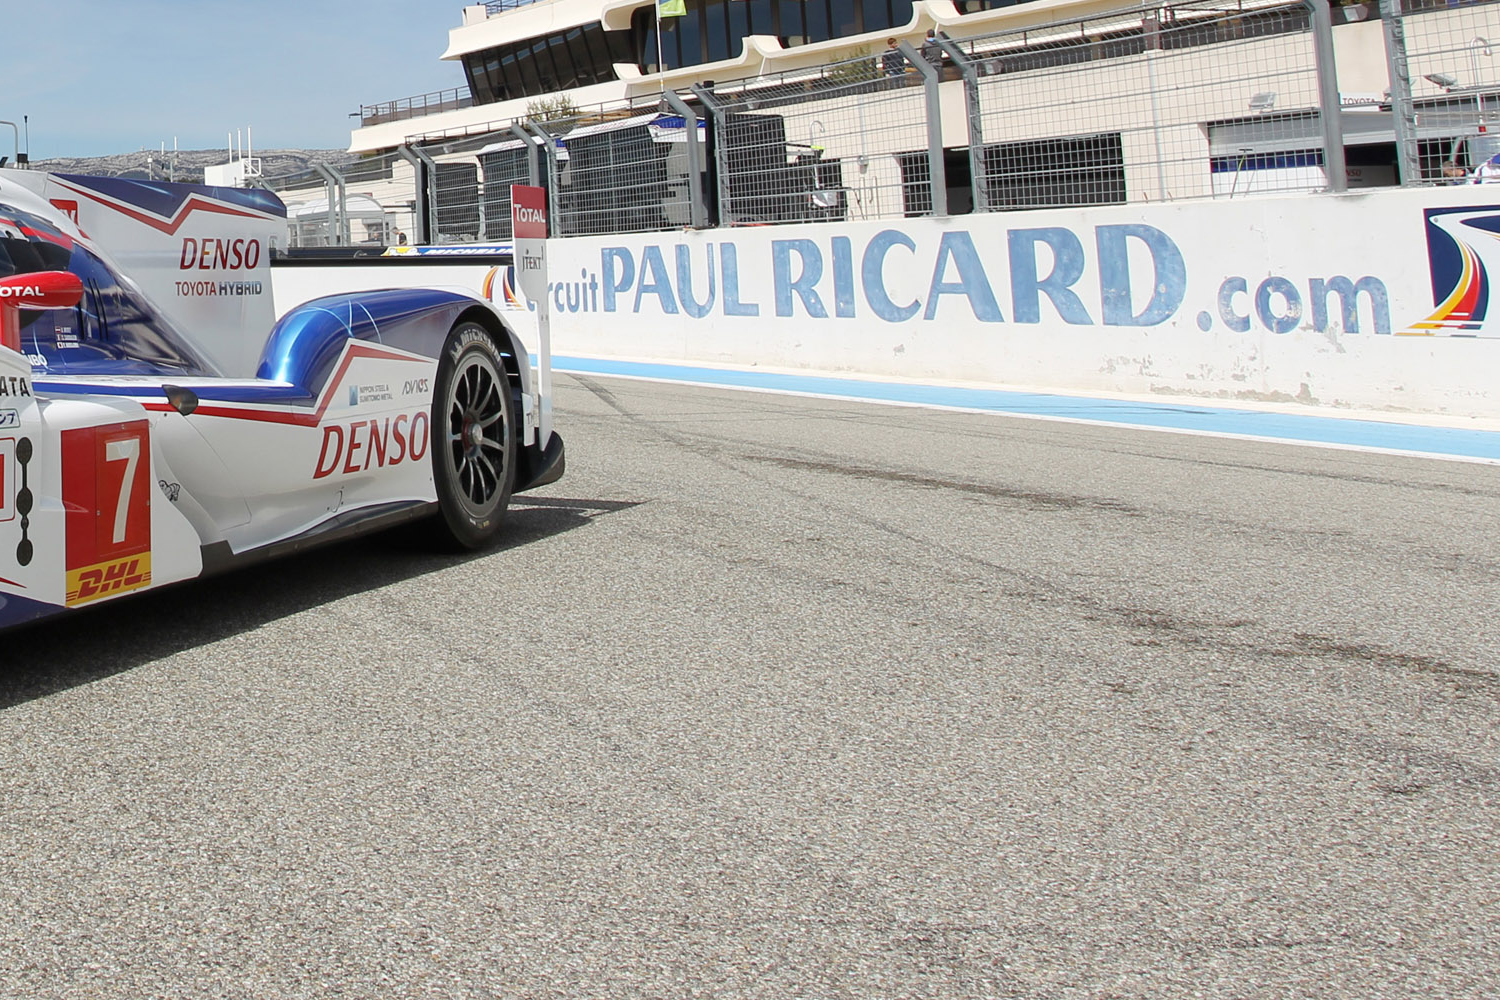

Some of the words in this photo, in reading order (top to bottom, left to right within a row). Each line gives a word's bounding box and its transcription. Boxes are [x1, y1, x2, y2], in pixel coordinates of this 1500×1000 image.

[514, 203, 546, 223] TOTAL
[180, 238, 261, 270] DENSO
[601, 243, 760, 319] PAUL
[771, 223, 1188, 326] RICARD
[175, 281, 217, 296] TOYOTA
[219, 280, 262, 296] HYBRID
[313, 411, 429, 479] DENSO
[106, 438, 141, 544] 7
[77, 559, 146, 600] DHL
